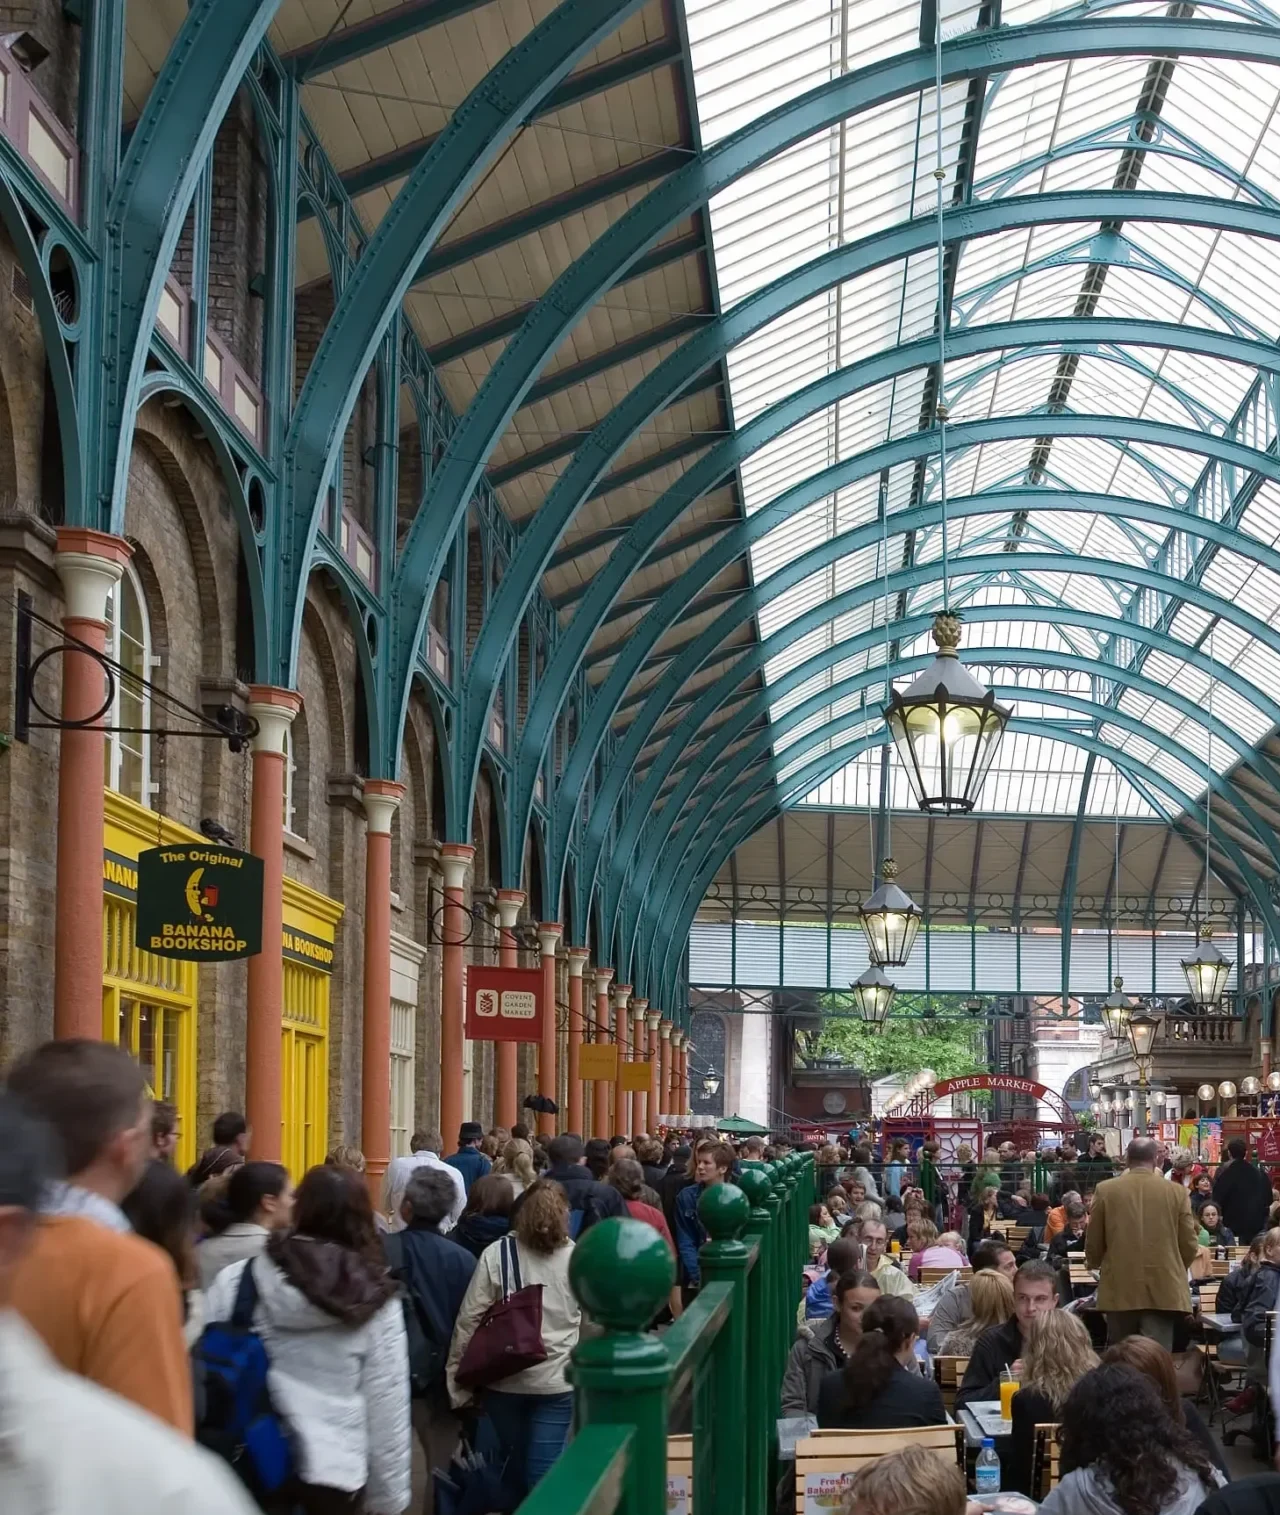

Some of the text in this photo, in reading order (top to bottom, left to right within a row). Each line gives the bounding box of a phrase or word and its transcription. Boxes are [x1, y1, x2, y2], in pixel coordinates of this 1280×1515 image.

[159, 850, 243, 869] The Original
[102, 859, 138, 891] NANA
[162, 923, 235, 939] BANANA
[150, 936, 247, 952] BOOKSHOP
[294, 936, 334, 964] BOOKSHOP
[947, 1077, 1036, 1093] APPLE MARKET
